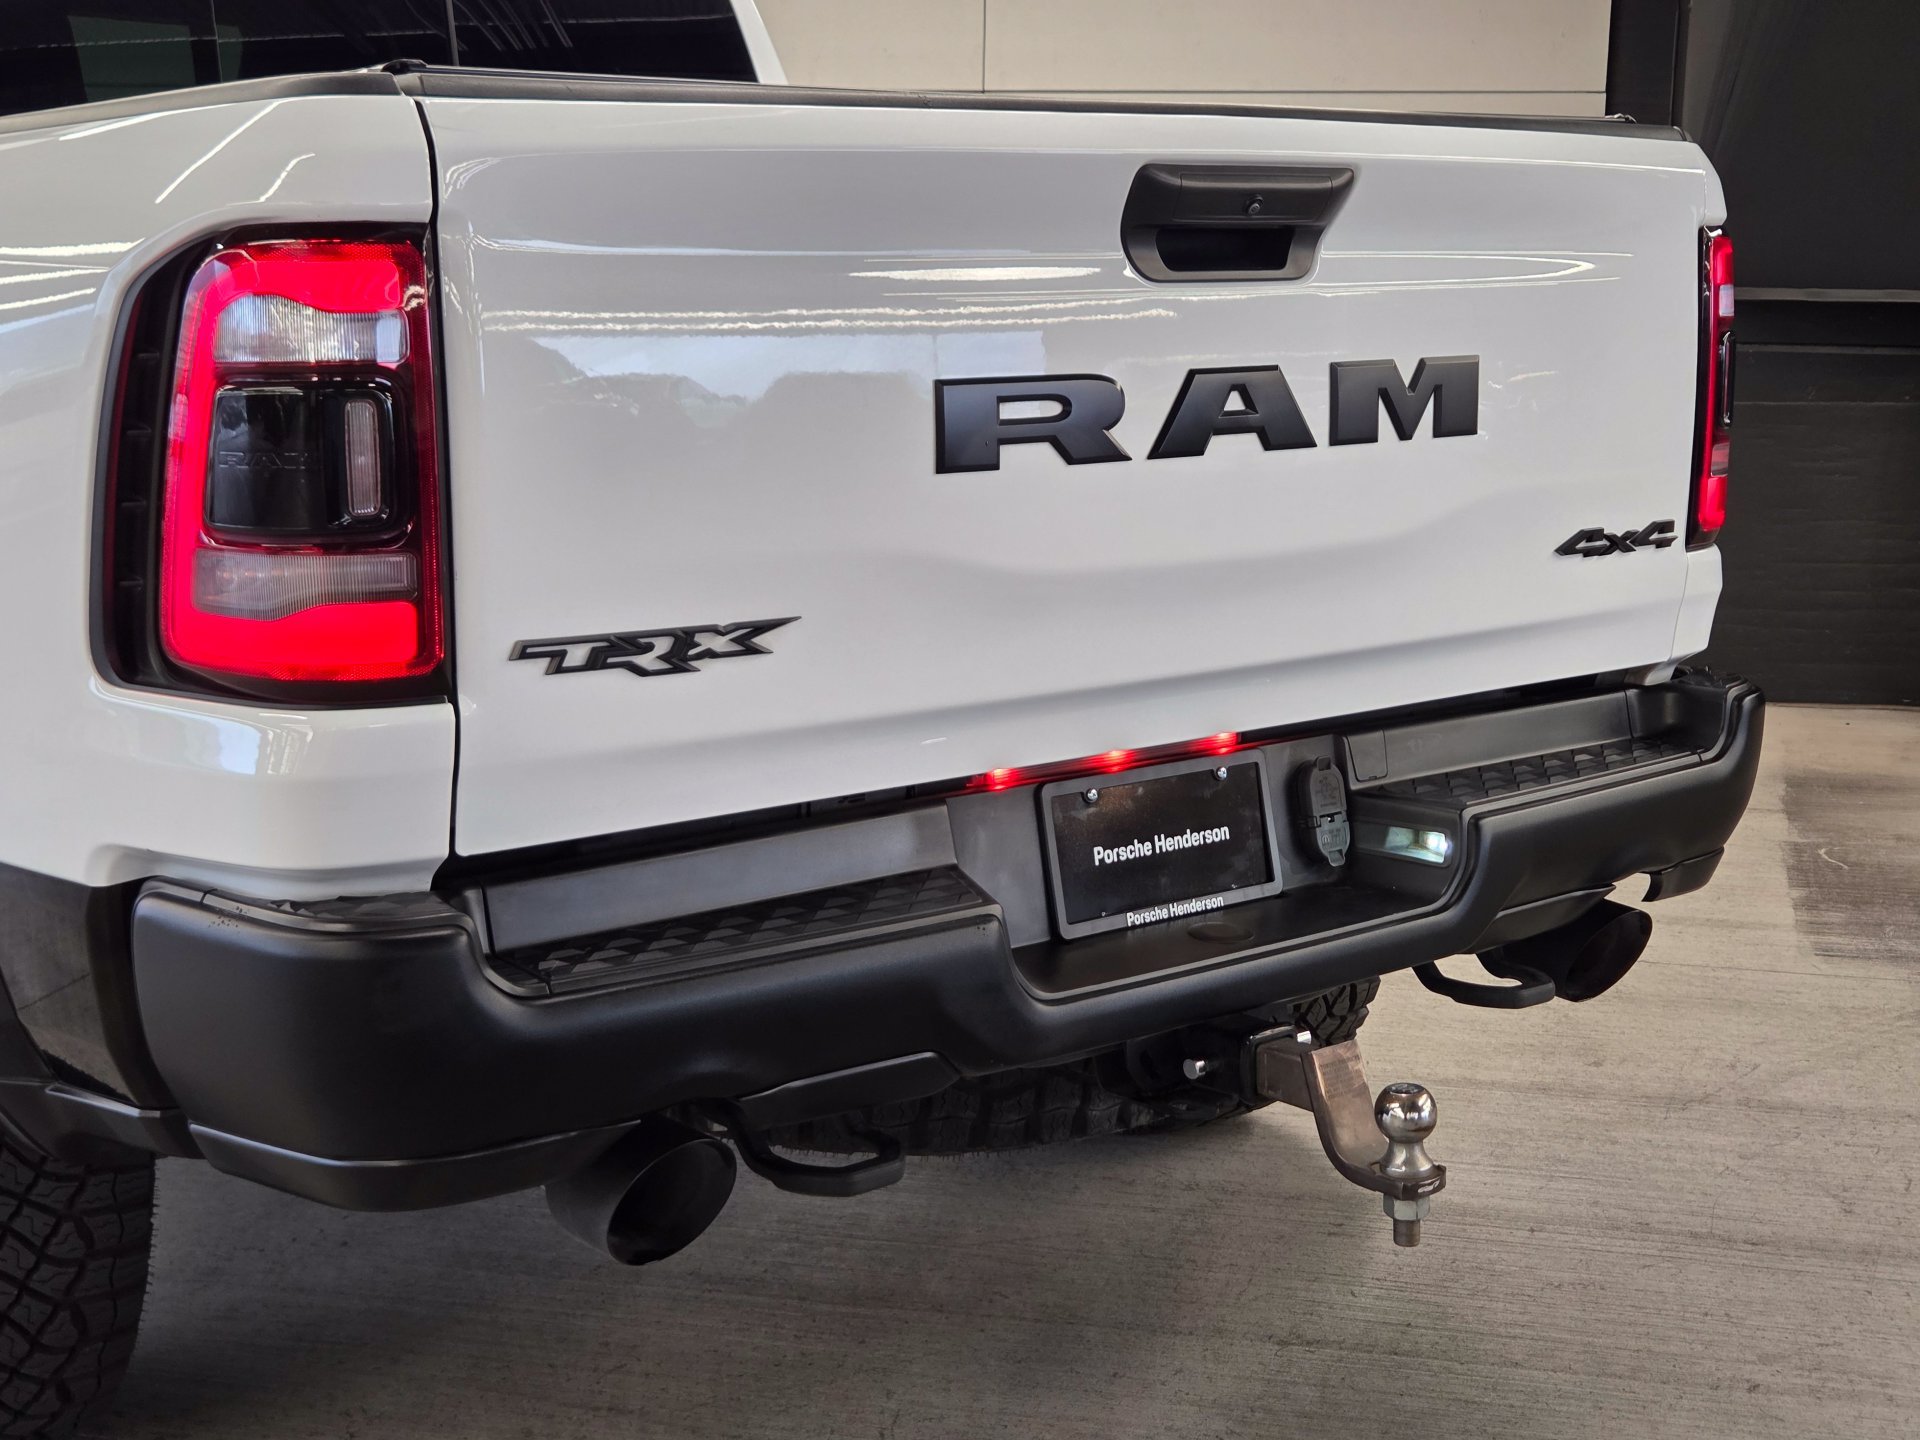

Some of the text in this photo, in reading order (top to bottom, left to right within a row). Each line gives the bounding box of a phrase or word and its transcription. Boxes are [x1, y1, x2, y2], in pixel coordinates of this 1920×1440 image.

[935, 355, 1480, 474] RAM
[508, 616, 802, 677] TRX
[1093, 825, 1230, 866] Porsche Henderson
[1126, 896, 1224, 927] Porsche Henderson
